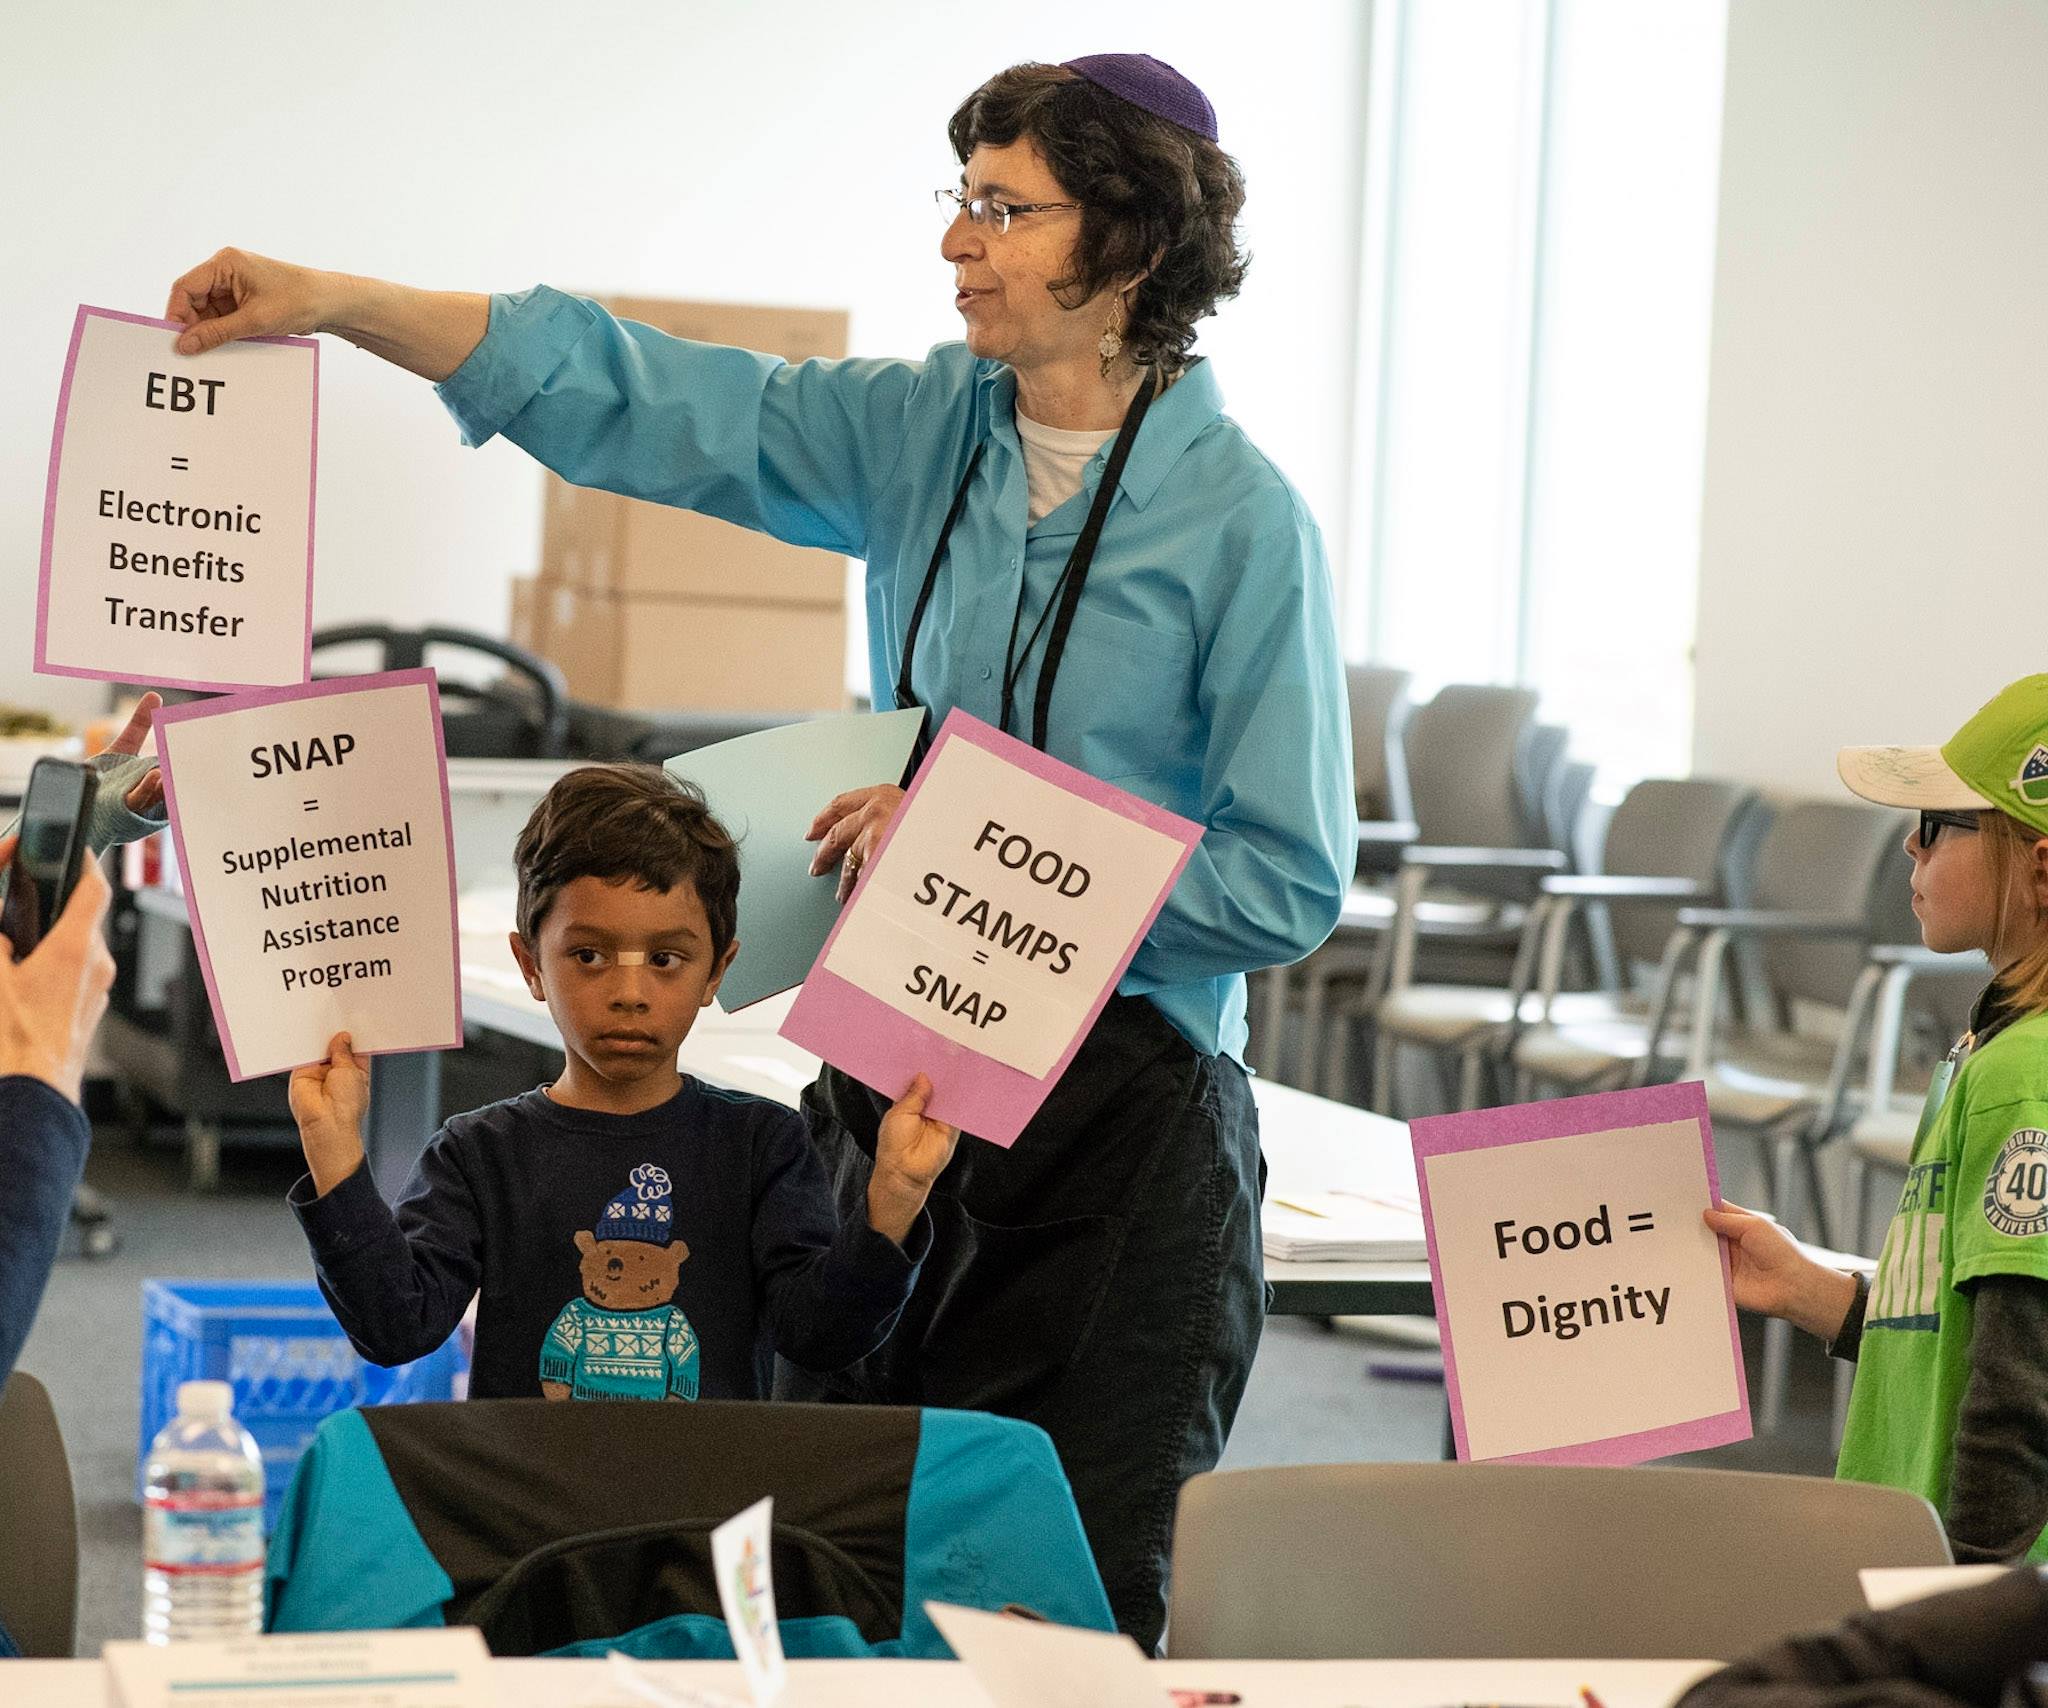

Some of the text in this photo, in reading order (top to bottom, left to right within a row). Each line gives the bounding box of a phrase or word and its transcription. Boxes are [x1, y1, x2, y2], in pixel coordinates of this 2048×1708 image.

[145, 371, 226, 416] EBT
[170, 456, 189, 471] =
[99, 489, 261, 535] Electronic
[109, 542, 245, 583] Benefits
[104, 596, 244, 638] Transfer
[250, 733, 356, 779] SNAP
[303, 799, 319, 812] =
[222, 821, 412, 874] Supplemental
[973, 820, 1091, 899] FOOD
[260, 872, 387, 910] Nutrition
[262, 914, 400, 954] Assistance
[913, 871, 1080, 975] STAMPS
[281, 957, 392, 992] Program
[972, 949, 989, 966] =
[904, 964, 1007, 1030] SNAP
[2006, 1162, 2047, 1201] 40
[1494, 1204, 1655, 1260] Food =
[1984, 1204, 2048, 1236] ANNIVERS
[1501, 1284, 1671, 1341] Dignity
